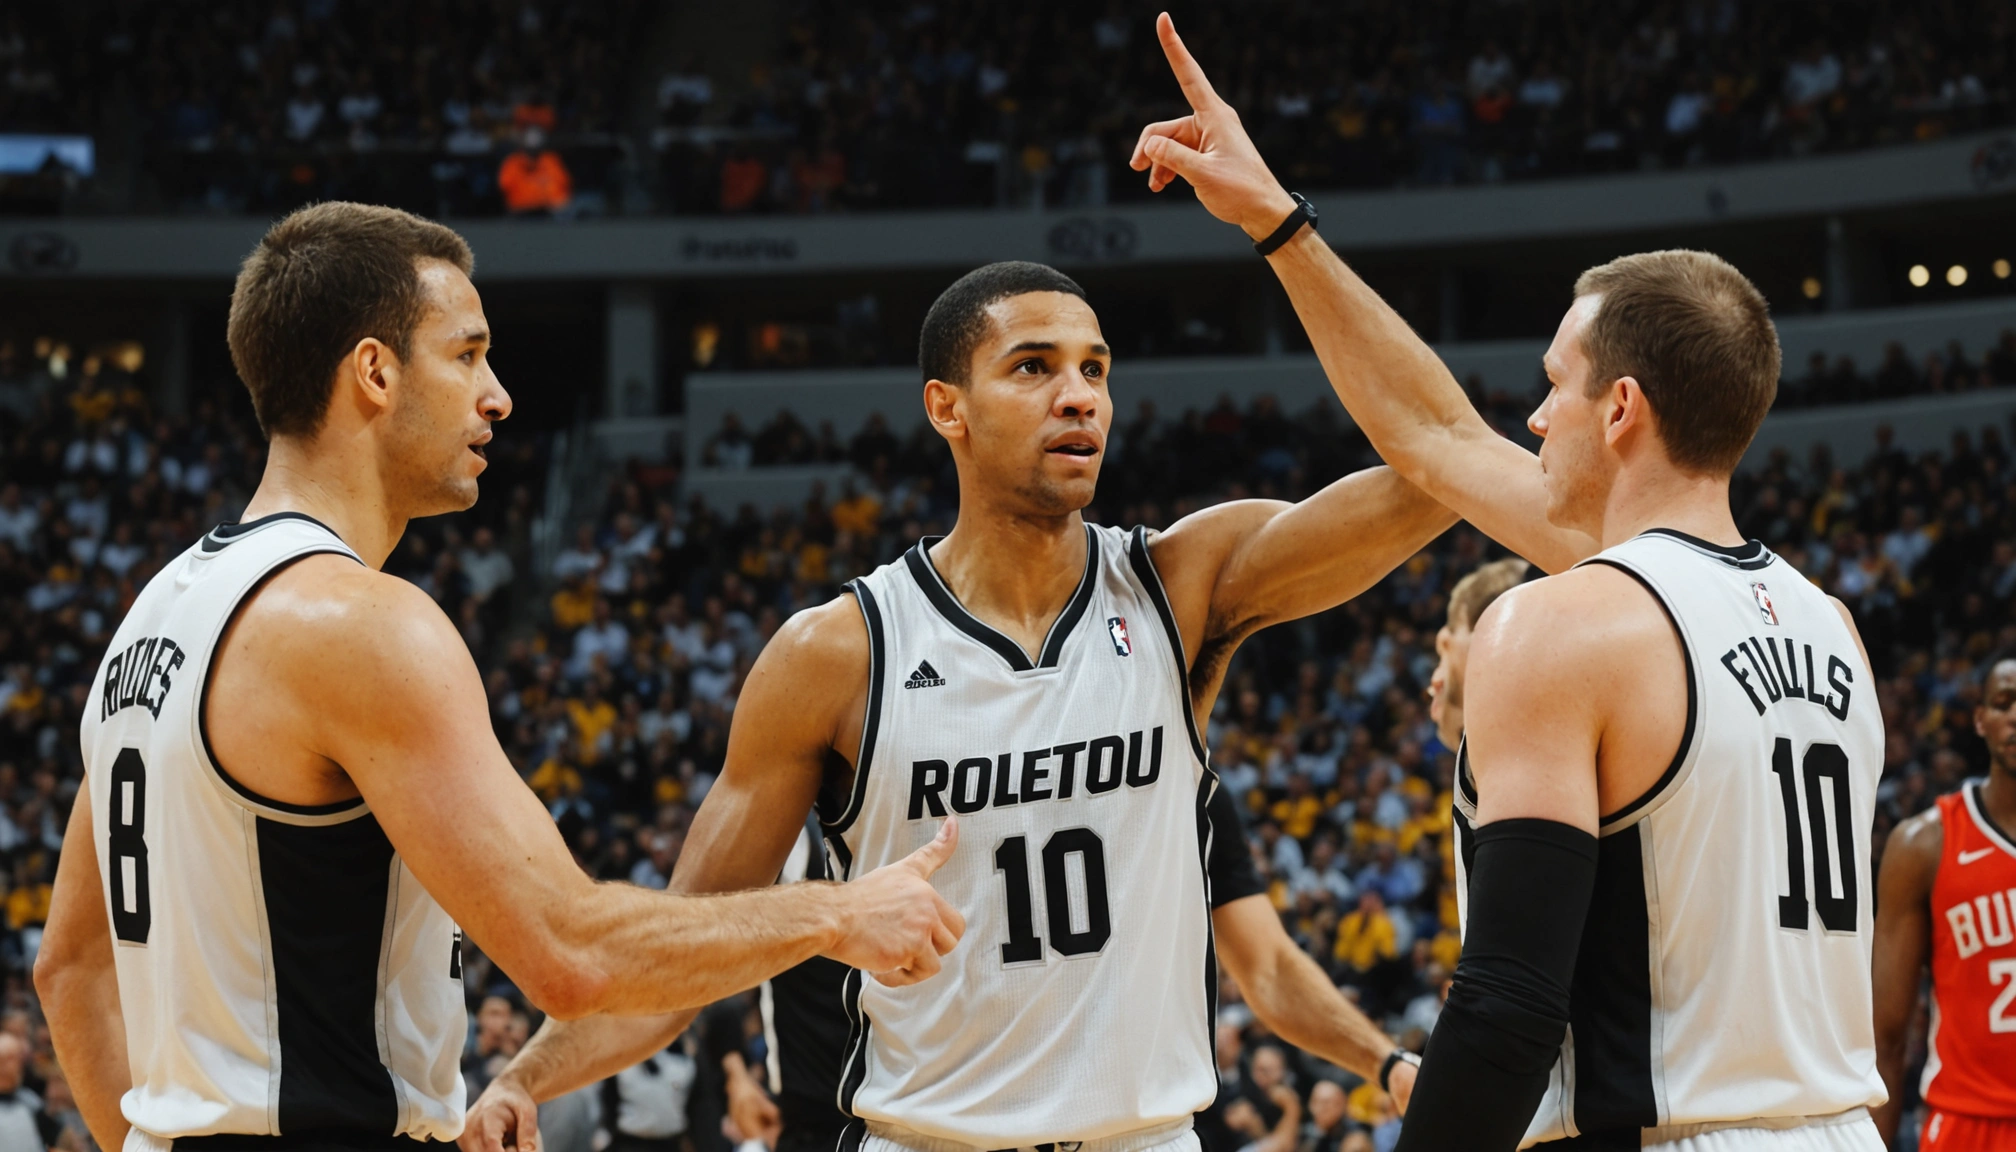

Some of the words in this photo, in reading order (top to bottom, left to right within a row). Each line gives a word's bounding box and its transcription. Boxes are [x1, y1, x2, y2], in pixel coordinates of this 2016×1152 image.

[907, 725, 1163, 821] ROLETOU
[1772, 736, 1858, 932] 10
[109, 747, 151, 944] 8
[994, 826, 1112, 965] 10
[1946, 886, 2016, 959] BU
